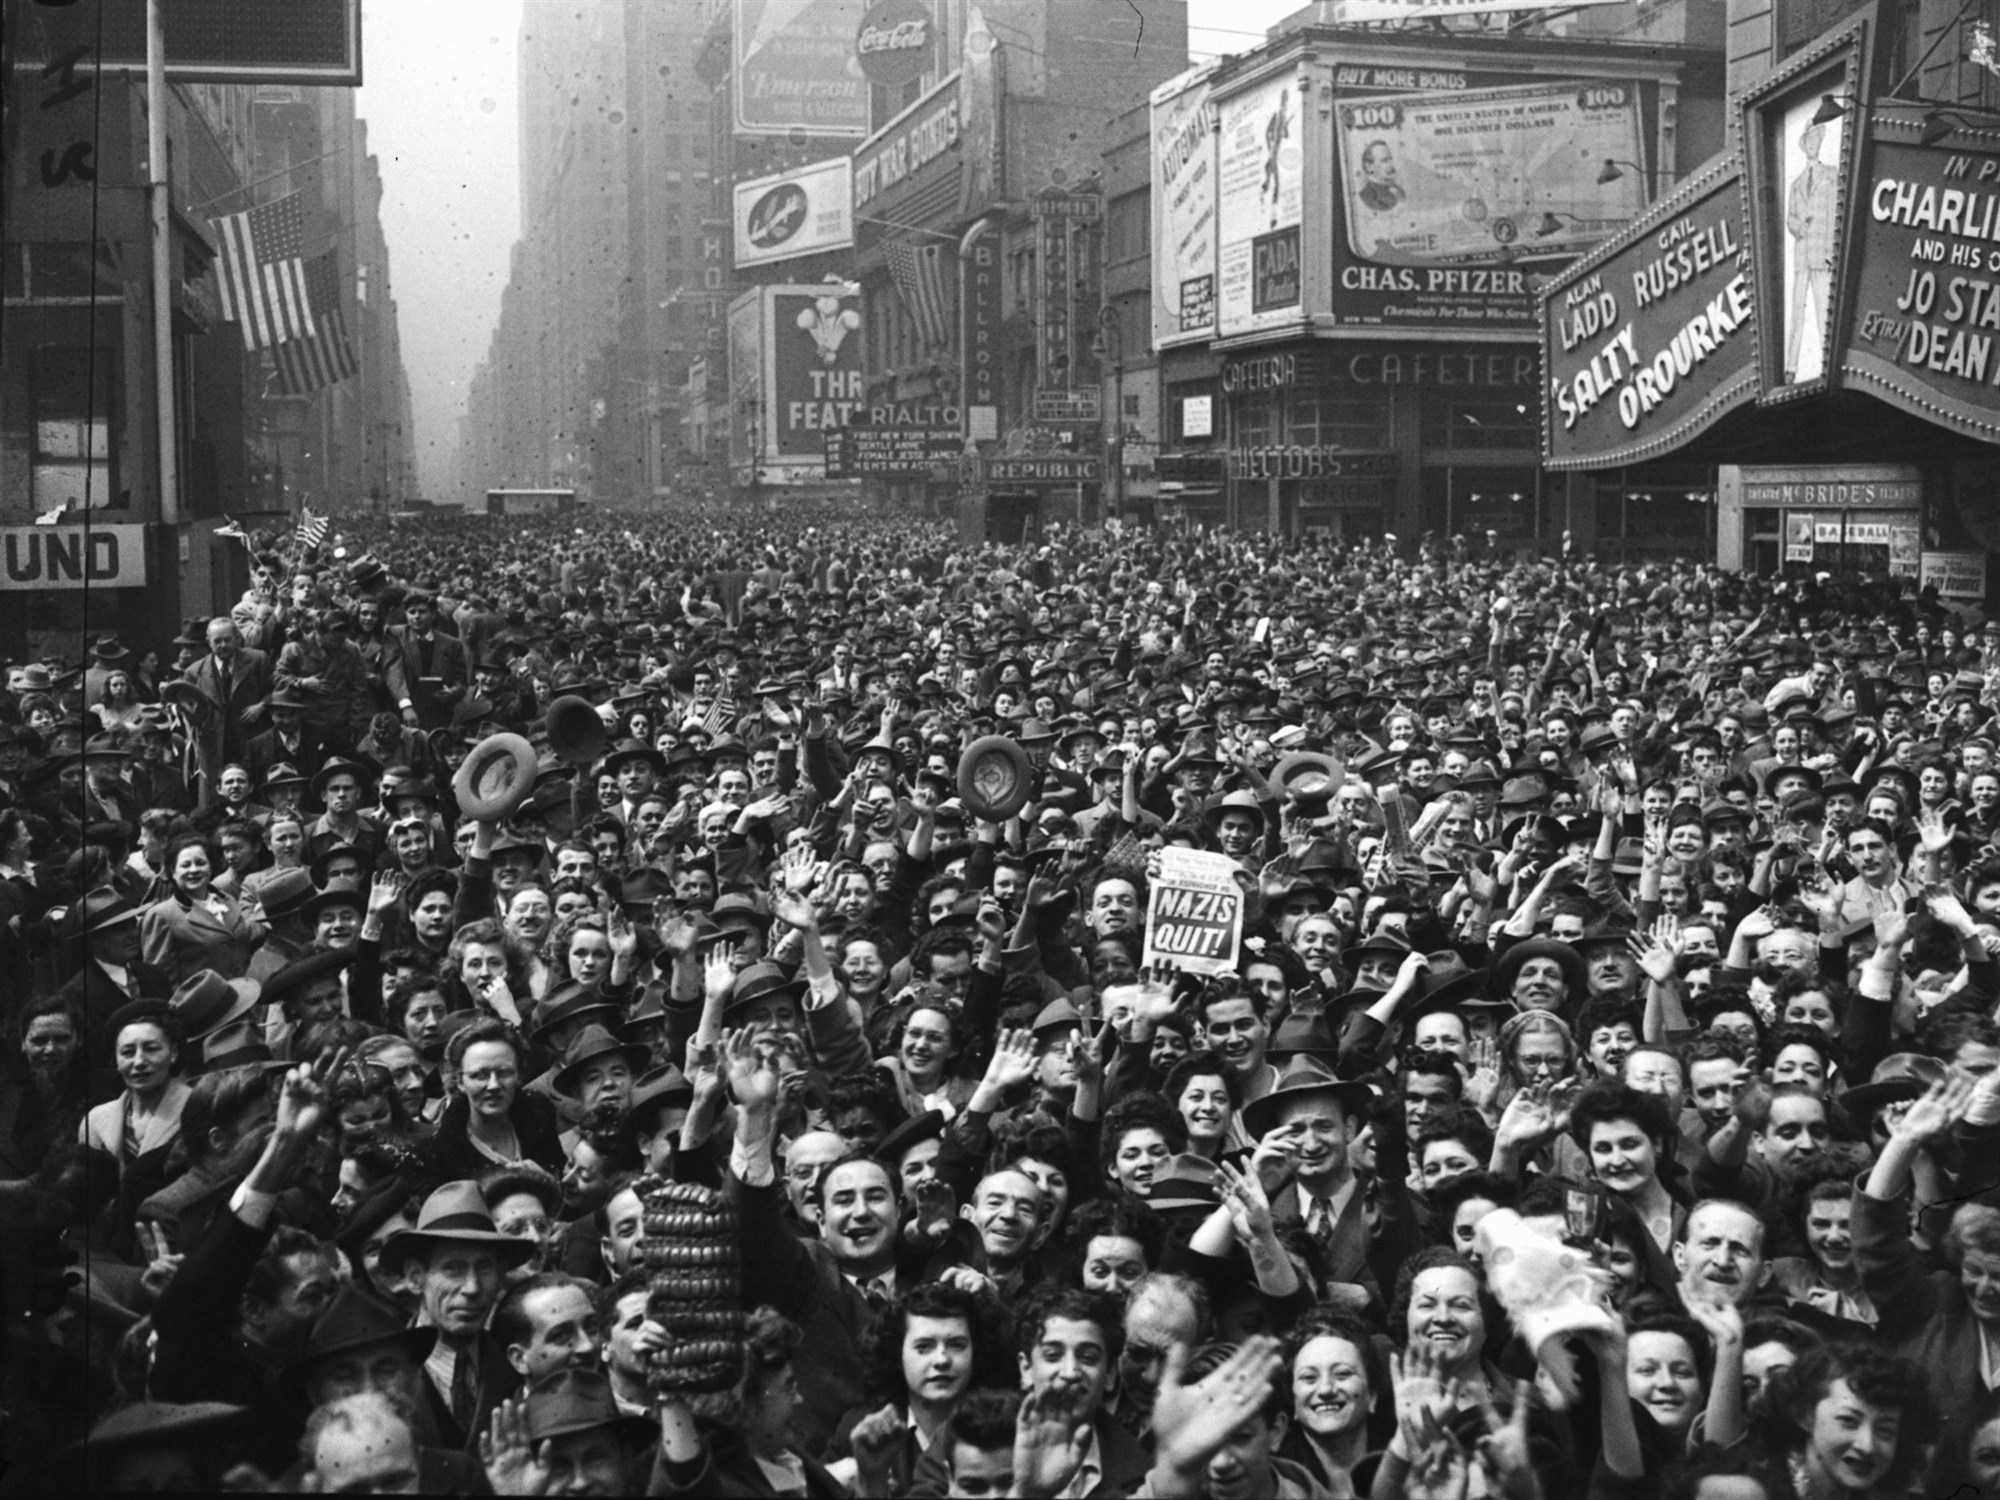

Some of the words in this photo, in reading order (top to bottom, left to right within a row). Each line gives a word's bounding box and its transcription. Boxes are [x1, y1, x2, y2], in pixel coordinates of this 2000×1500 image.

[858, 19, 927, 54] Coca-Cola
[1337, 68, 1368, 84] BUY
[1374, 70, 1415, 88] MORE
[1419, 72, 1467, 89] BONDS
[1528, 102, 1569, 114] AMERICA
[1586, 87, 1625, 106] 100
[1352, 106, 1396, 127] 100
[1506, 119, 1555, 131] DOLLARS
[1944, 155, 1971, 178] IN
[1659, 217, 1695, 250] GAIL
[1633, 219, 1737, 307] RUSSELL
[1911, 238, 1945, 262] AND
[1951, 243, 1981, 268] HIS
[1341, 266, 1421, 291] CHAS.
[1427, 270, 1525, 294] PFIZER
[1565, 274, 1602, 309] ALAN
[1897, 268, 1935, 315] JO
[976, 247, 991, 402] BALLROOM
[1384, 305, 1437, 317] Chemicals
[1438, 306, 1456, 318] For
[1486, 308, 1504, 319] Who
[1559, 291, 1618, 351] LADD
[1908, 320, 1991, 382] DEAN
[1222, 354, 1295, 392] CAFETERIA
[1350, 353, 1533, 385] CAFETER
[871, 404, 961, 426] RIALTO
[854, 431, 878, 441] FIRST
[880, 431, 900, 440] NEW
[903, 431, 925, 440] YORK
[858, 451, 894, 461] FEMALE
[991, 462, 1097, 479] REPUBLIC
[1818, 526, 1888, 538] BAEBALL
[4, 530, 119, 581] UND
[1156, 888, 1236, 923] NAZIS
[1154, 923, 1226, 956] QUIT!
